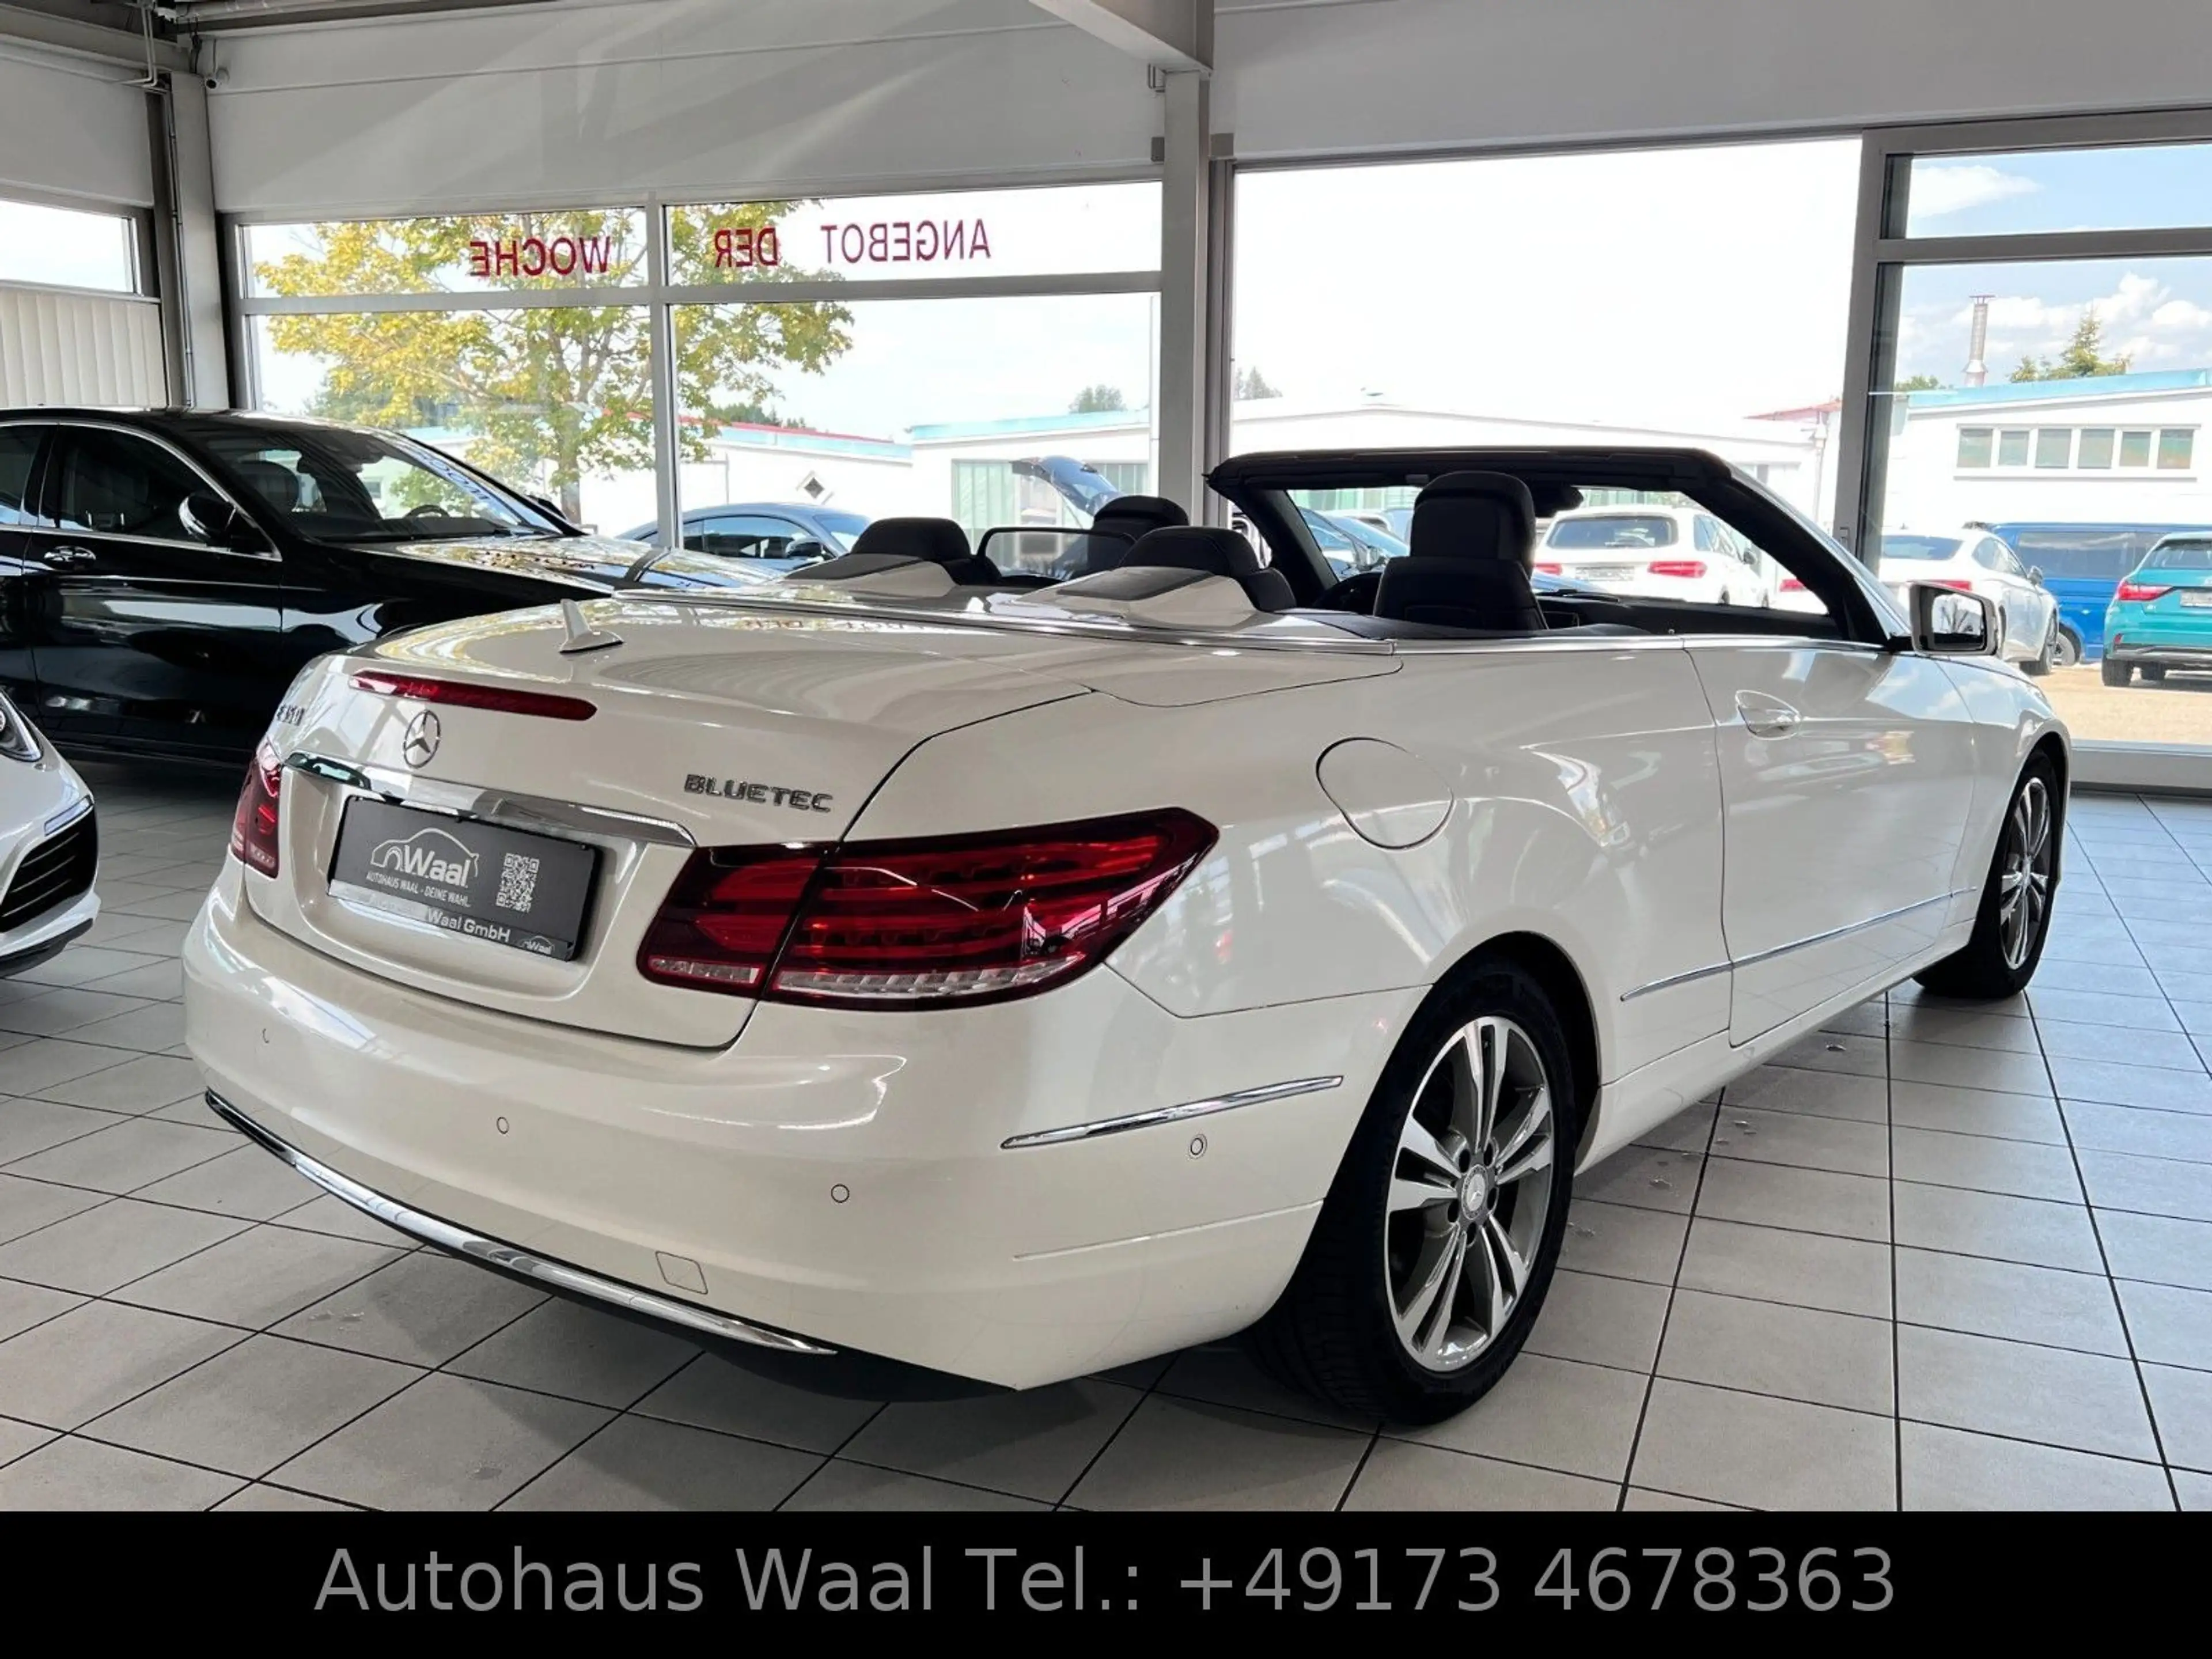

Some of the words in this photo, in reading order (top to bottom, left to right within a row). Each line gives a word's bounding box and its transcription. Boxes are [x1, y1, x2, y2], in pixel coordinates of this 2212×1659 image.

[684, 774, 834, 813] BLUETEC
[366, 870, 399, 889] AUTOHAUS
[400, 878, 419, 894] WAAL
[424, 885, 449, 902] DEINE
[427, 907, 462, 930] Waal
[463, 918, 512, 942] GmbH
